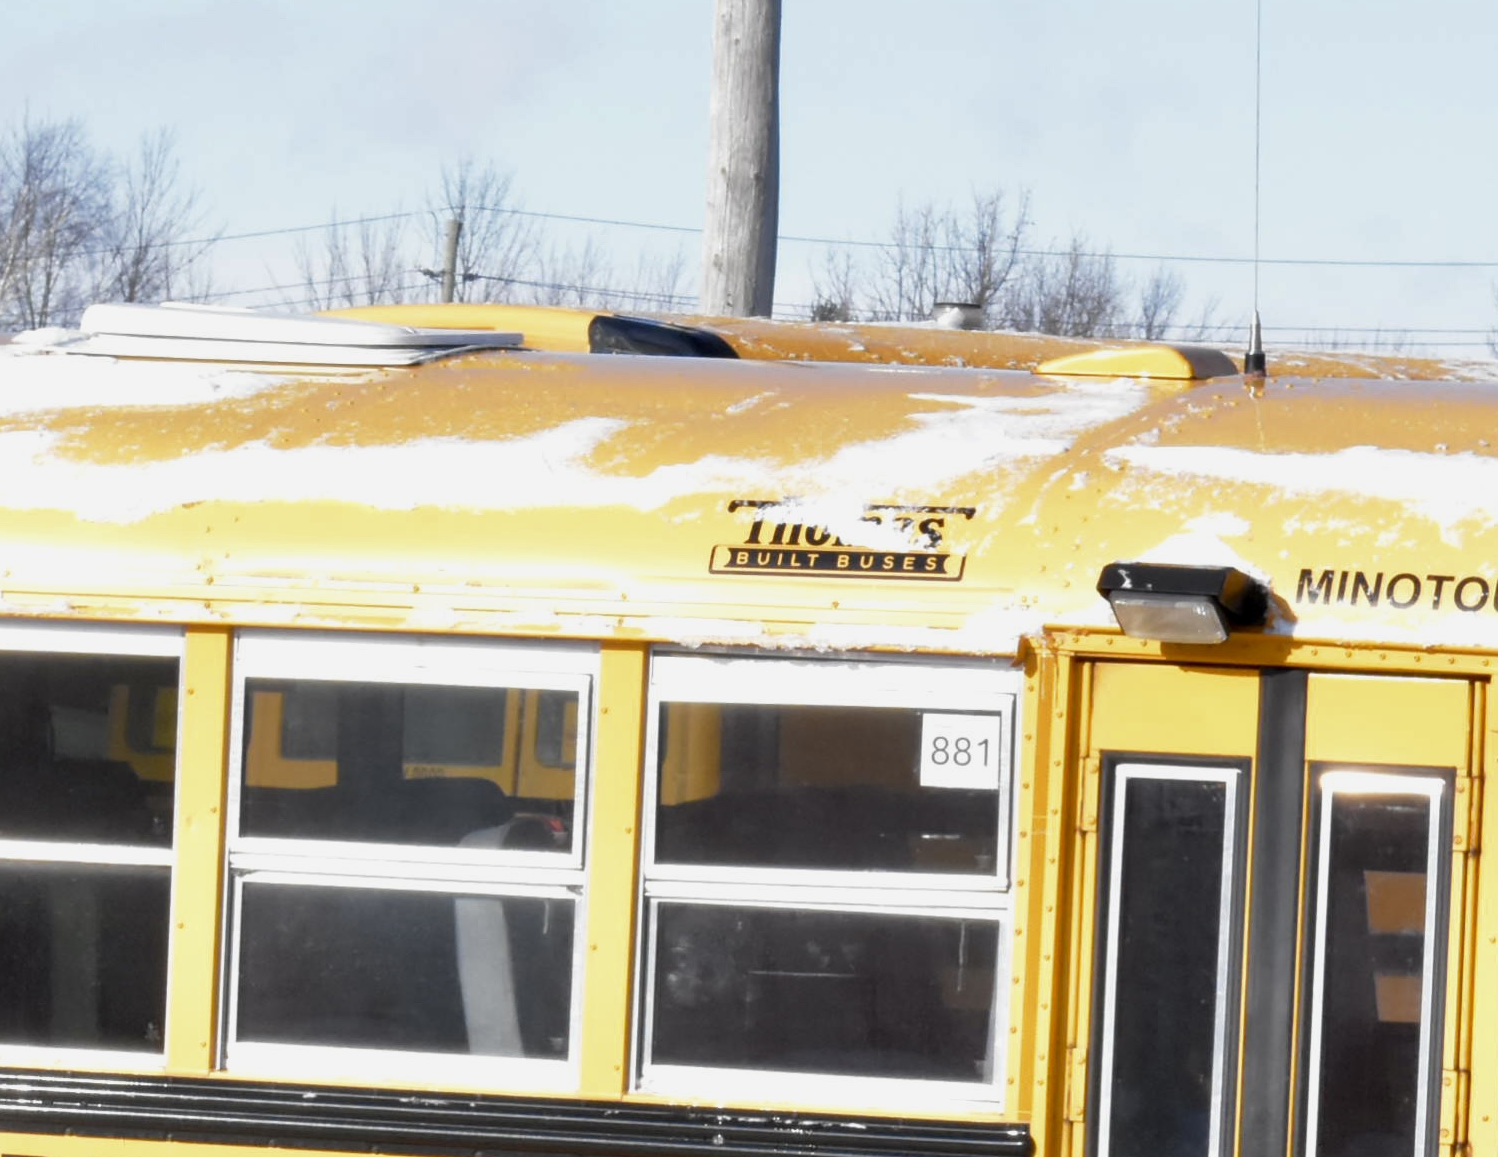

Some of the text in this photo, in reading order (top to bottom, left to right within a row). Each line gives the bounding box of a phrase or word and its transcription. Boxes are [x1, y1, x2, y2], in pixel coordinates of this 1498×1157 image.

[735, 551, 938, 572] BUILT BUSES
[931, 735, 989, 767] 881
